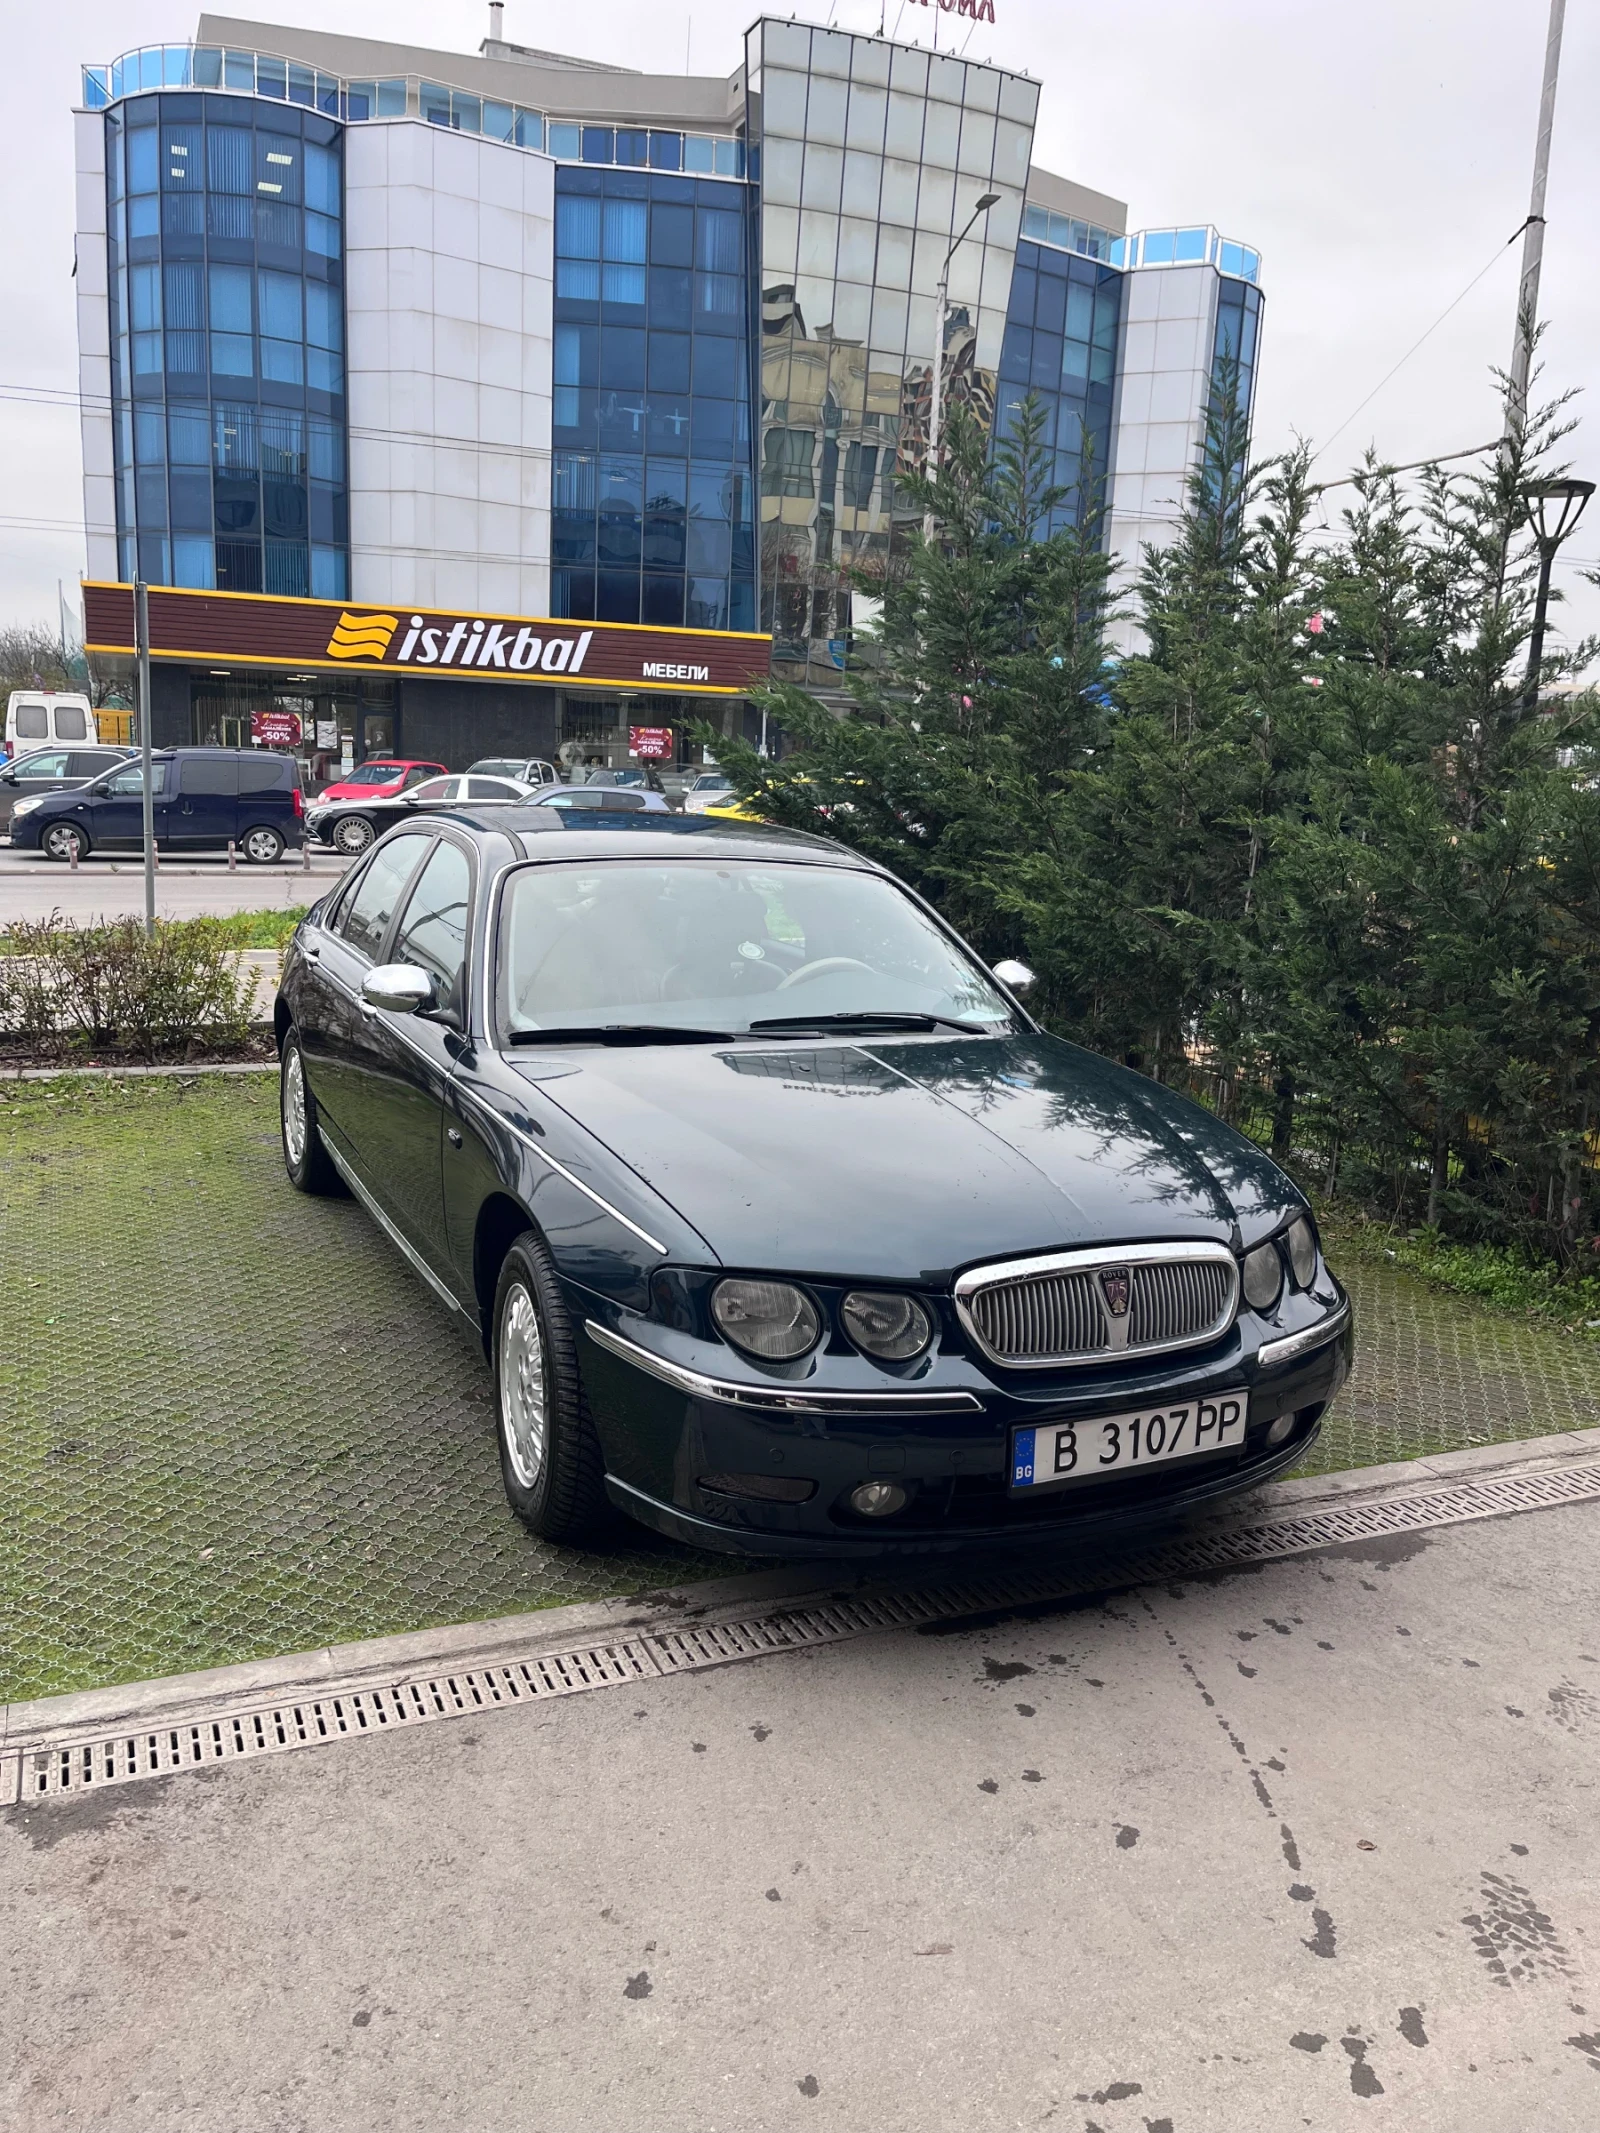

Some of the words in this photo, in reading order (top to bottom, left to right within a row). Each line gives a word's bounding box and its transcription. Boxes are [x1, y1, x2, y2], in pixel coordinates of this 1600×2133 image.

[397, 615, 594, 673] istikbal
[642, 662, 709, 681] МЕБЕЛИ
[262, 732, 290, 740] -50%
[1102, 1270, 1127, 1279] ROVER
[1054, 1429, 1077, 1473] B
[1015, 1465, 1033, 1480] BG
